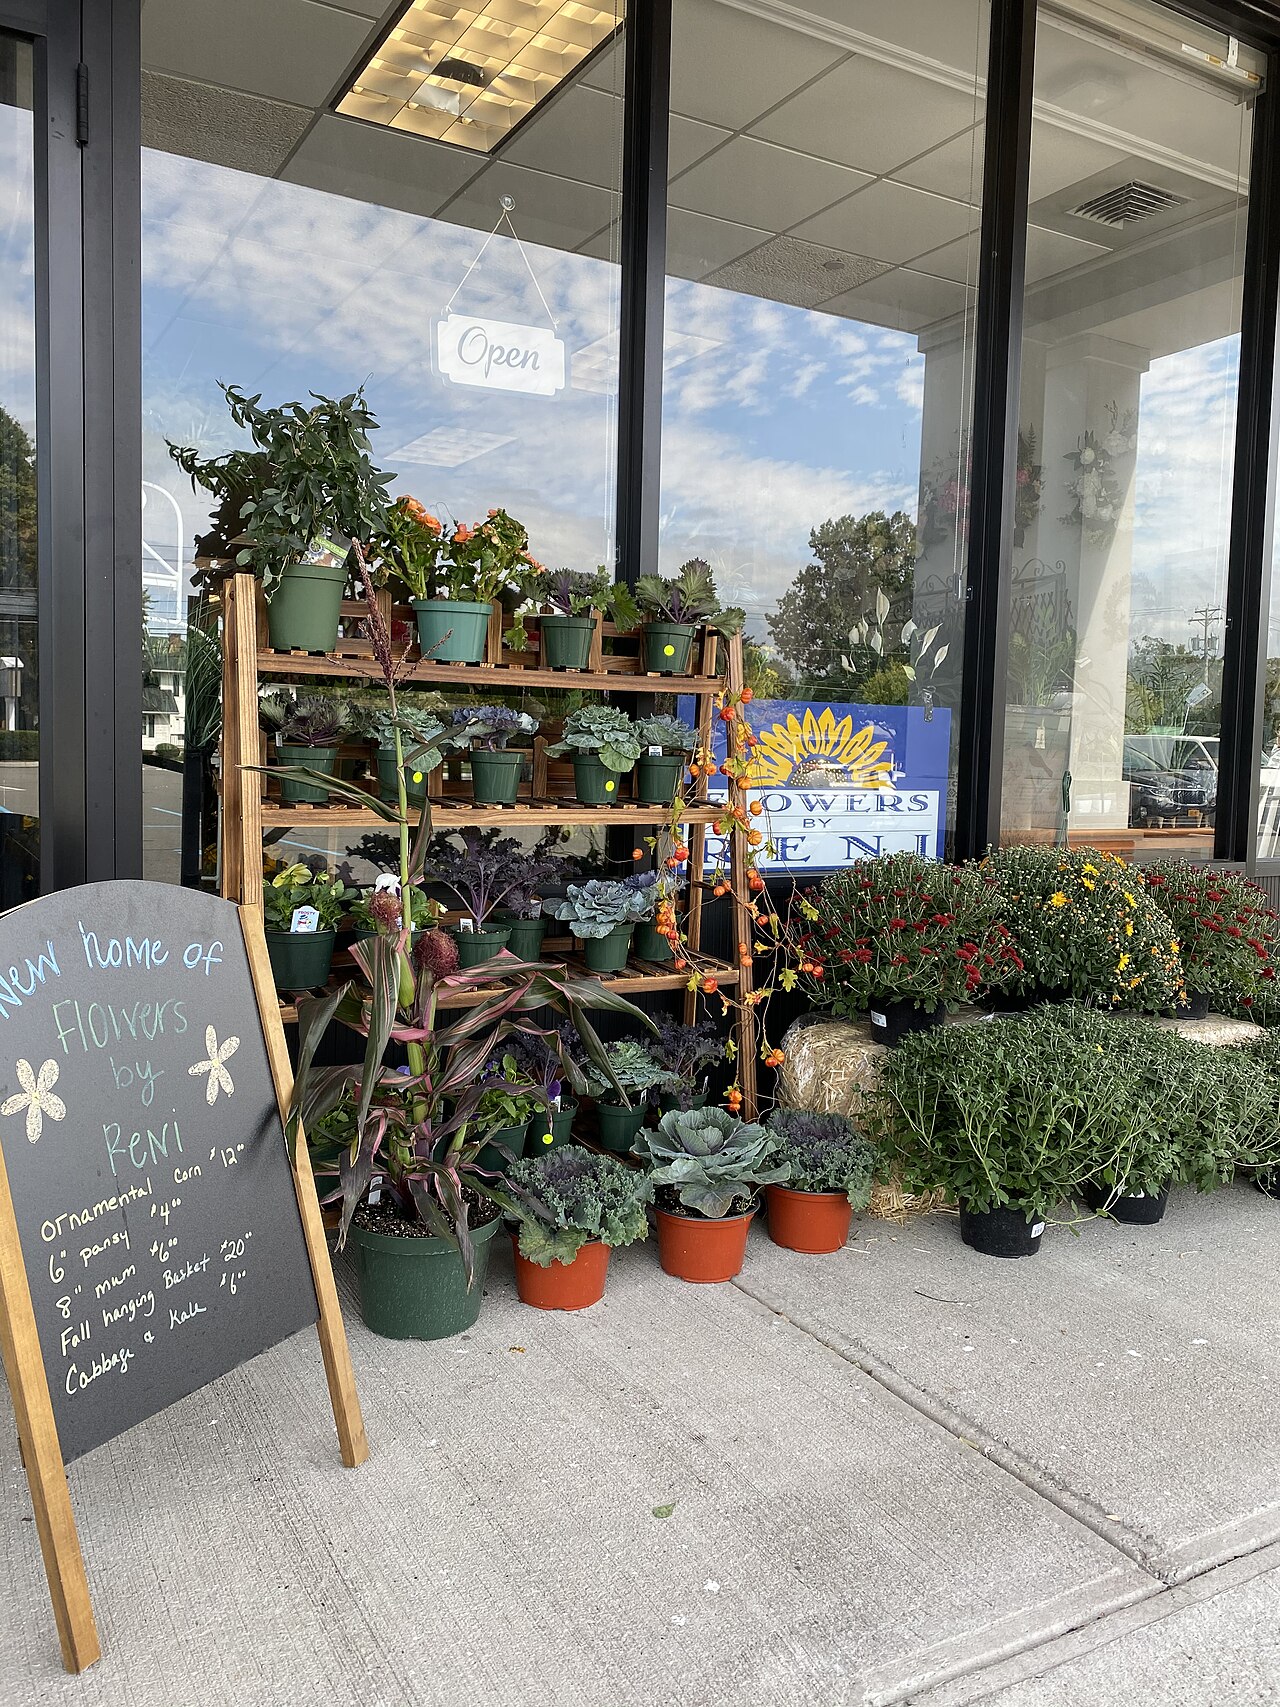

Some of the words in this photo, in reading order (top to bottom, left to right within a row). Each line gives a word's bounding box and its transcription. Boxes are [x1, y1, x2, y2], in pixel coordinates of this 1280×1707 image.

[458, 326, 540, 379] Open
[802, 818, 832, 829] BY
[183, 940, 223, 975] of
[109, 1056, 164, 1107] by
[79, 1229, 130, 1268] pansy
[55, 1284, 82, 1319] 8"
[94, 1264, 136, 1299] mum
[60, 1319, 91, 1356] Fall
[102, 1291, 156, 1327] hanging
[162, 1253, 211, 1289] Basket
[168, 1301, 207, 1330] Kale
